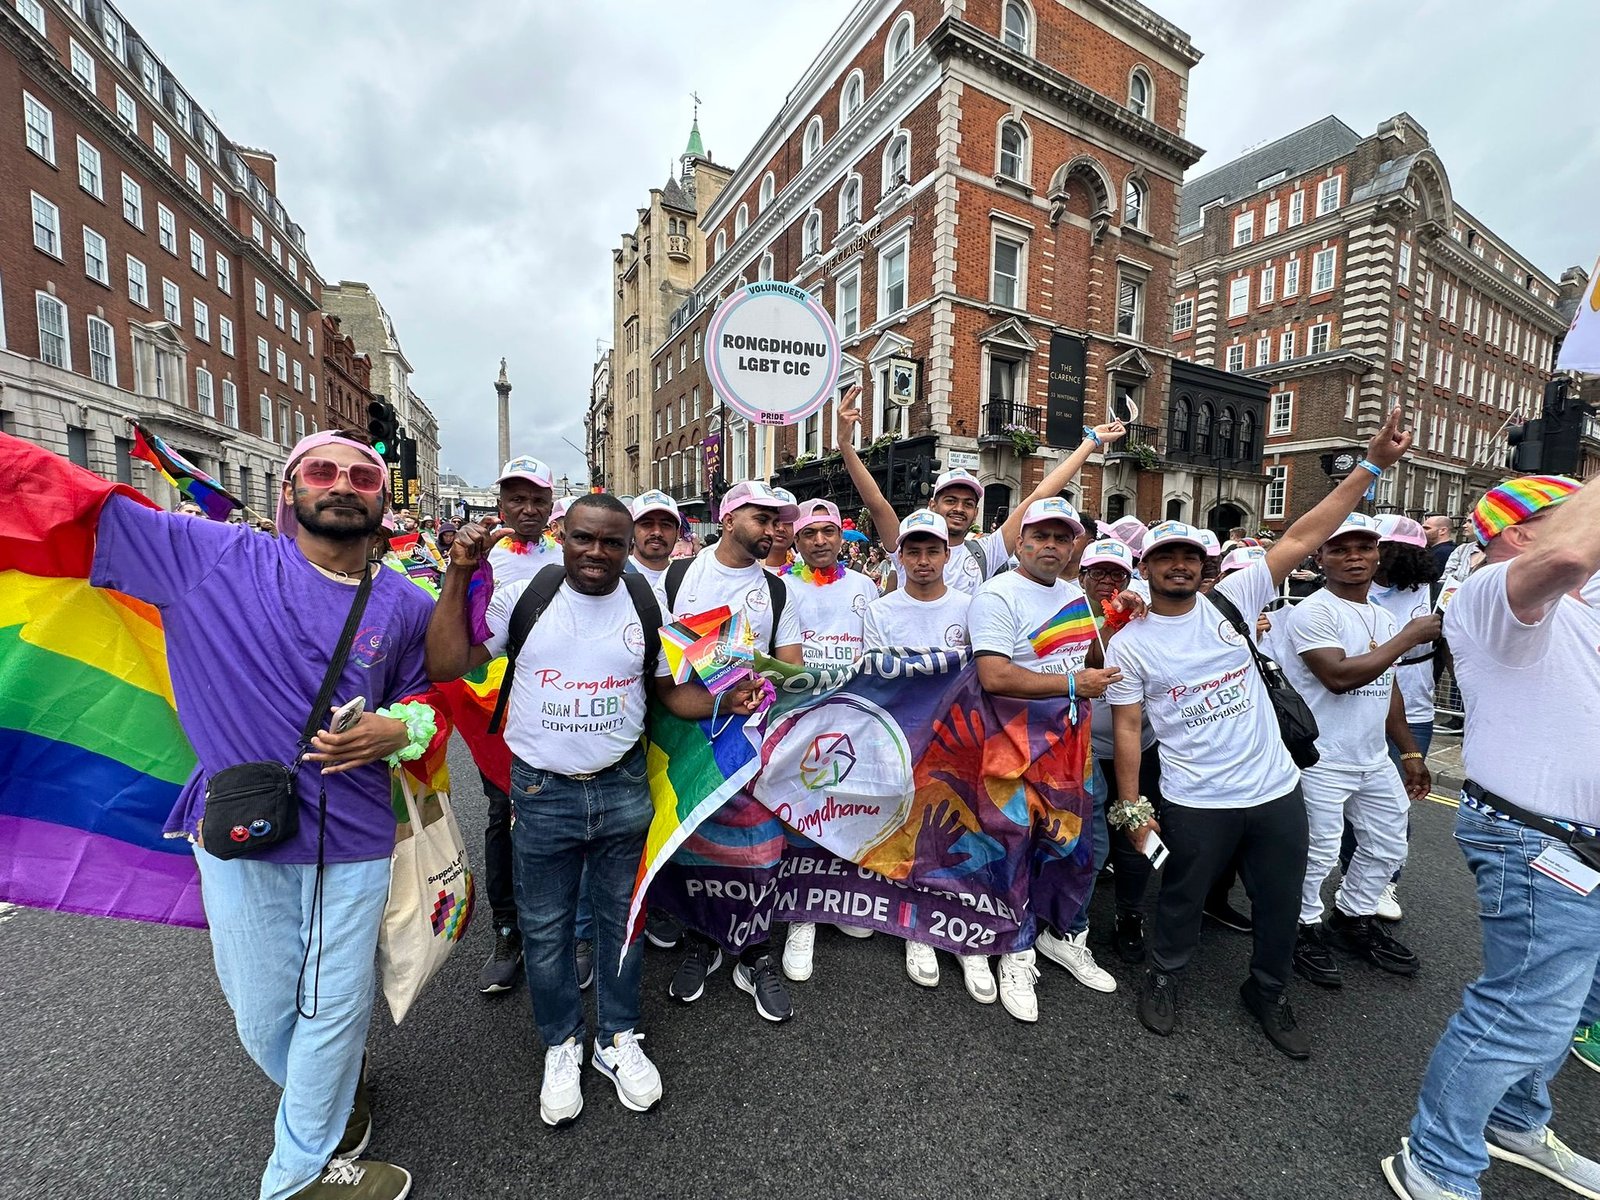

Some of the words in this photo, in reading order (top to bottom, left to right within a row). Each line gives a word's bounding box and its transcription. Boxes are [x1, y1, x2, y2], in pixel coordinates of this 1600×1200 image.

[837, 223, 881, 264] CLARENCE
[748, 283, 805, 301] VOLUNQUEER
[722, 334, 827, 358] RONGDHONU
[738, 356, 780, 373] LGBT
[782, 361, 811, 376] CIC
[1060, 363, 1073, 373] THE
[1049, 371, 1082, 385] CLARENCE
[803, 649, 823, 658] ASIAN
[541, 701, 571, 718] ASIAN
[574, 693, 628, 718] LGBT
[1181, 703, 1208, 719] ASIAN
[541, 716, 627, 733] COMMUNITY
[805, 888, 890, 922] PRIDE
[929, 910, 997, 949] 2025
